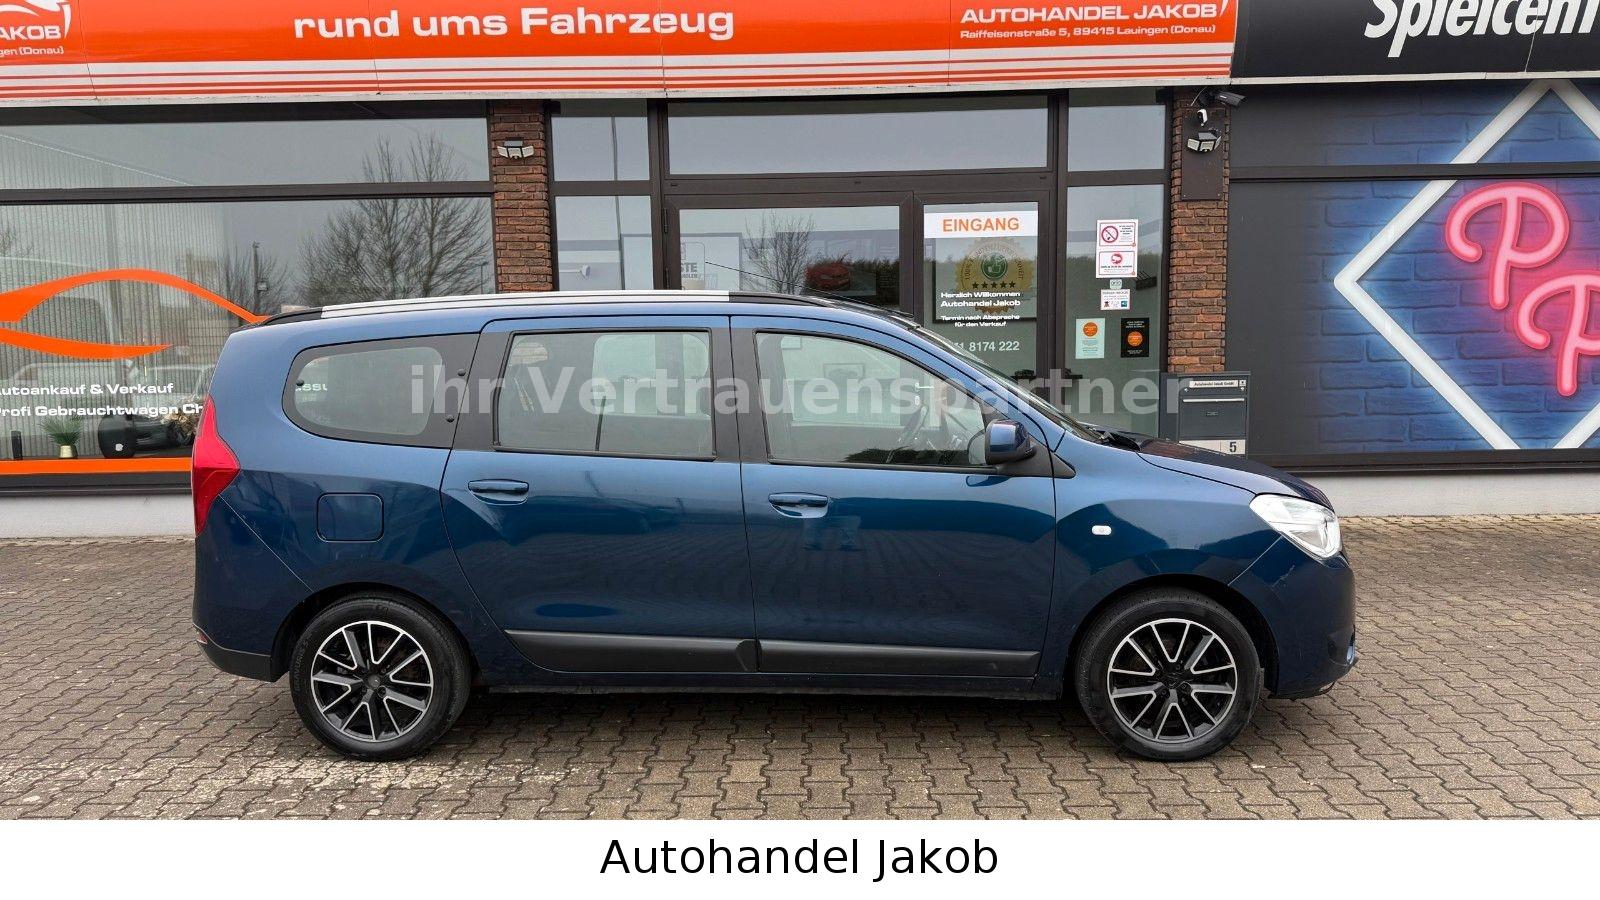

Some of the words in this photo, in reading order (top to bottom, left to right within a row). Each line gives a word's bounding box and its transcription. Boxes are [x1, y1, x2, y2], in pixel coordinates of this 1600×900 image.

[960, 5, 1129, 24] AUTOHANDEL
[1133, 3, 1218, 20] JAKOB
[294, 10, 399, 39] rund
[412, 14, 508, 37] ums
[521, 7, 735, 41] Fahrzeug
[960, 28, 1056, 39] Raiffeisenstraße
[1058, 27, 1071, 37] 5,
[1073, 26, 1115, 36] 89415
[1117, 25, 1169, 36] Lauingen
[1170, 24, 1216, 34] (Donau)
[19, 46, 64, 55] (Donau)
[942, 217, 1020, 232] EINGANG
[940, 300, 992, 308] Autohandel
[993, 299, 1021, 307] Jakob
[969, 341, 996, 352] 8174
[998, 340, 1020, 351] 222
[0, 384, 87, 396] utoankauf
[90, 384, 103, 395] &
[106, 383, 174, 395] Verkauf
[0, 406, 31, 417] rofi
[34, 404, 179, 418] Gebrauchtwagen
[1229, 441, 1237, 453] 5
